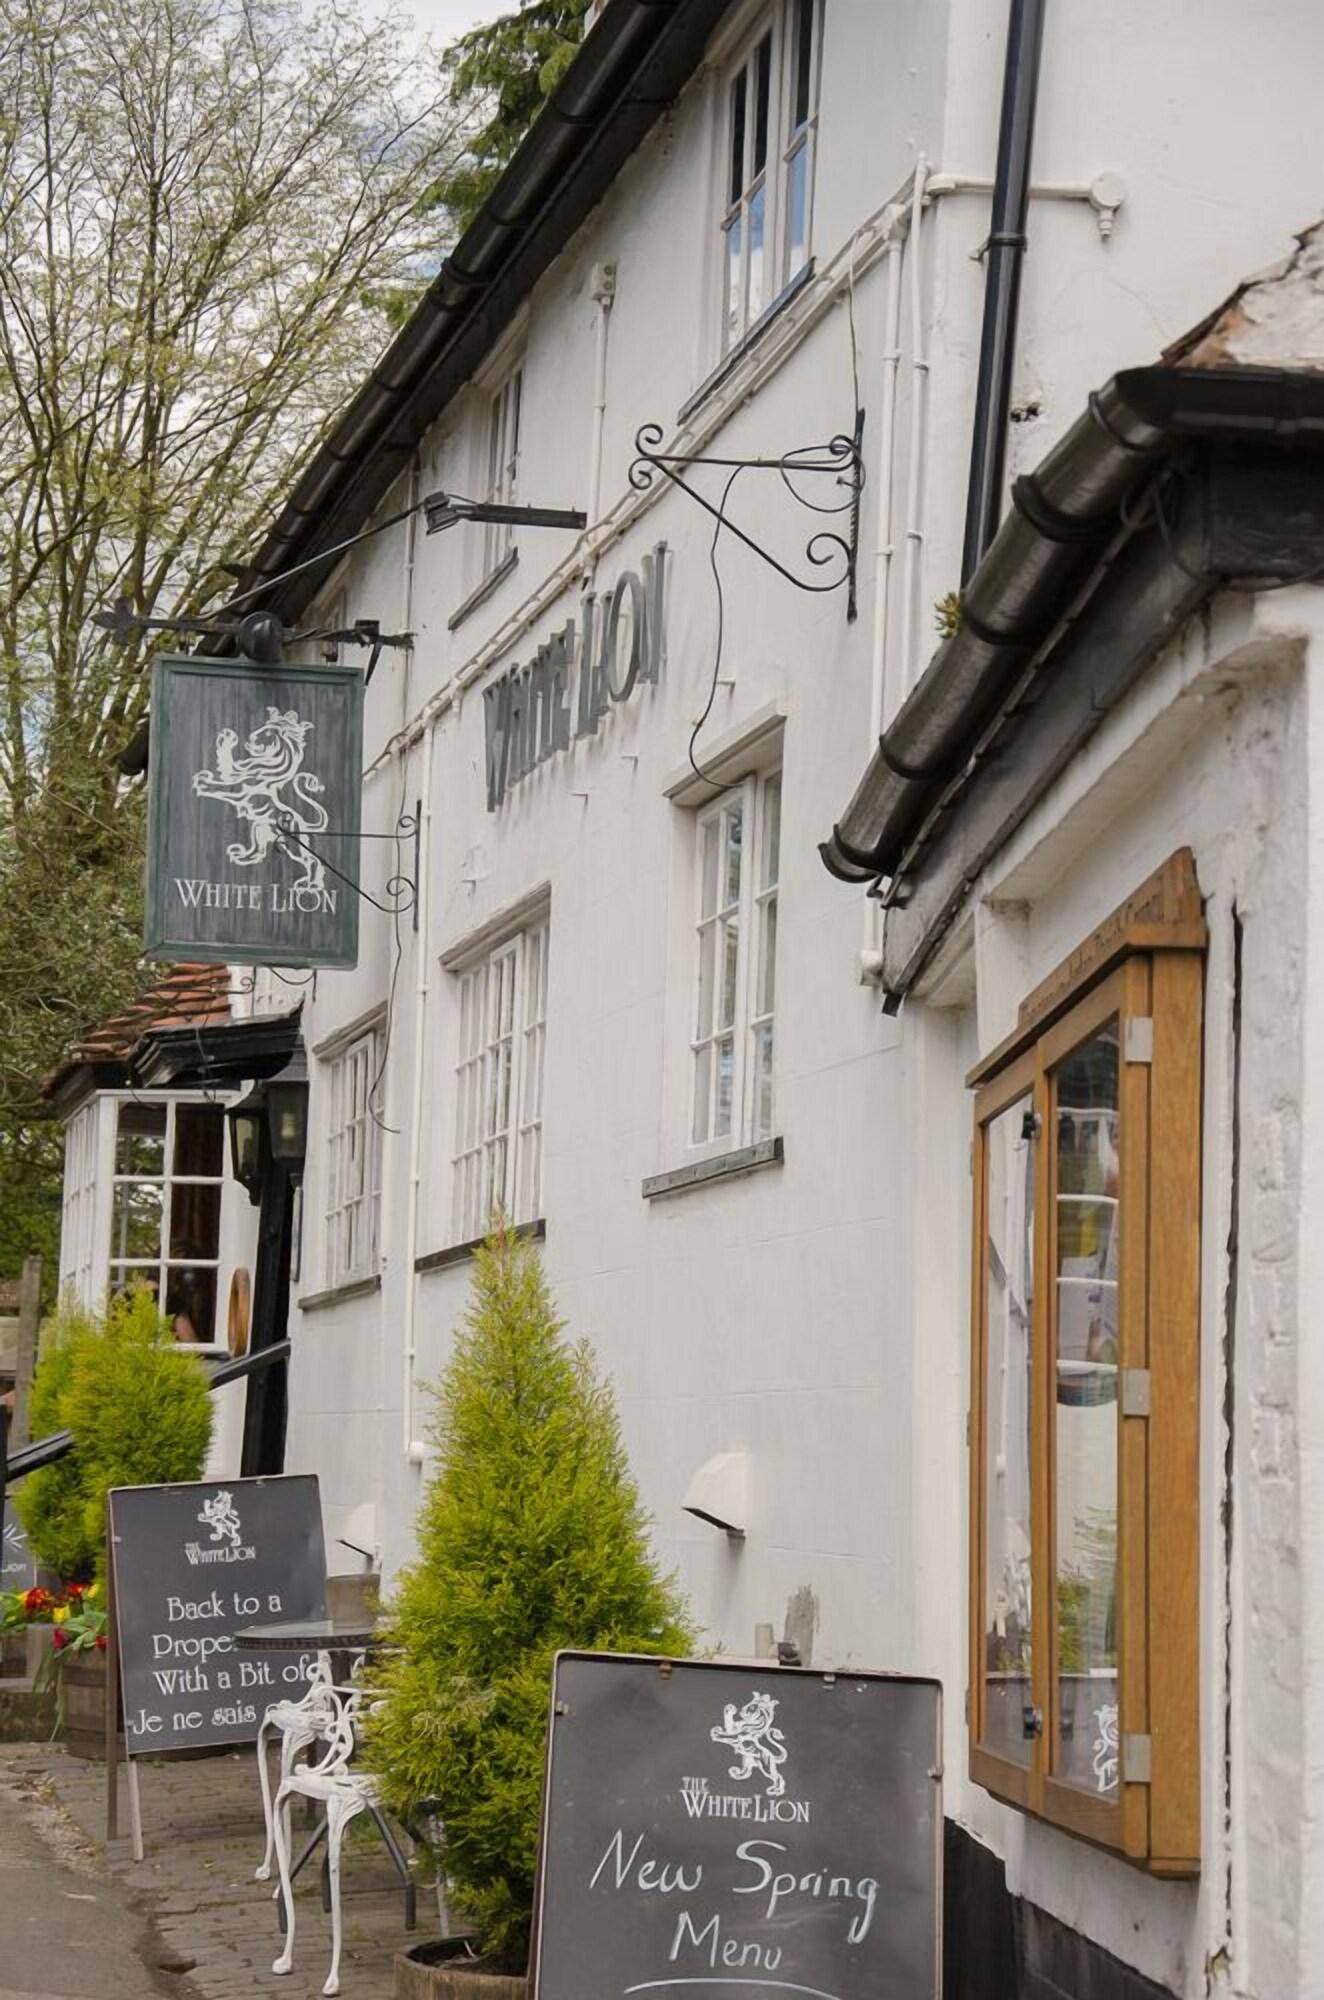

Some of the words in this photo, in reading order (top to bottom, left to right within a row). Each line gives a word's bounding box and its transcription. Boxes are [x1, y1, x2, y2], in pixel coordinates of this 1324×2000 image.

[573, 540, 668, 740] LION
[173, 878, 262, 910] WHITE
[271, 883, 337, 915] LION
[166, 1590, 226, 1622] Back
[233, 1591, 260, 1615] to
[267, 1595, 282, 1613] a
[153, 1665, 209, 1696] With
[217, 1671, 232, 1689] a
[239, 1661, 275, 1687] Bit
[282, 1654, 310, 1682] of
[132, 1708, 163, 1735] Je
[173, 1711, 203, 1731] ne
[211, 1699, 257, 1726] sais
[681, 1776, 708, 1792] THE
[680, 1789, 753, 1819] WHITE
[754, 1794, 811, 1823] LION
[589, 1828, 702, 1893] New
[732, 1839, 880, 1945] Spring
[668, 1911, 783, 1970] Menu
